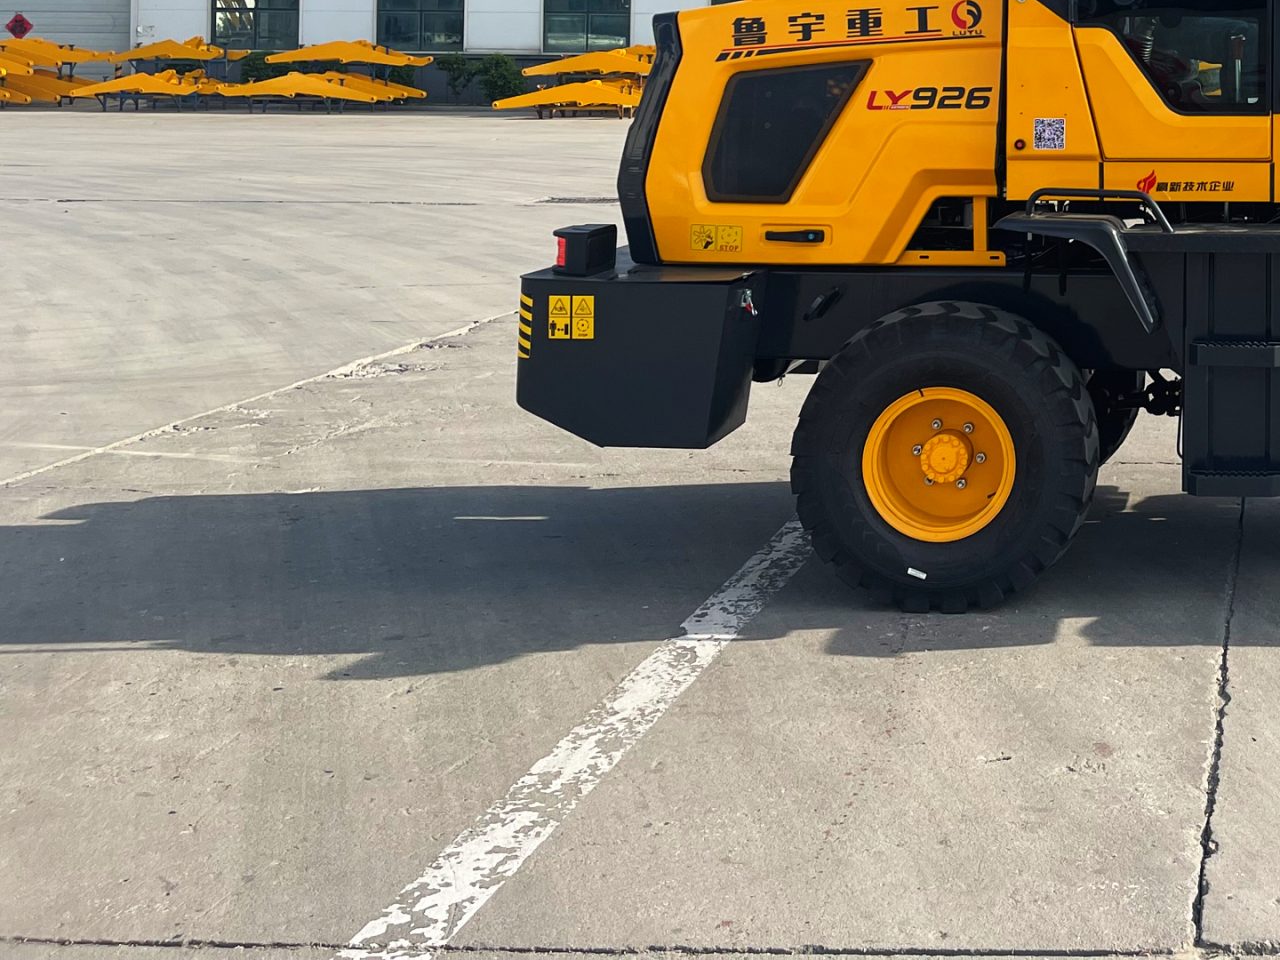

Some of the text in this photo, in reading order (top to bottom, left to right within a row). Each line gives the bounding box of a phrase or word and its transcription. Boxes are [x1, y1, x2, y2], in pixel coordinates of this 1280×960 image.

[732, 6, 942, 46] 鲁宇重工
[866, 86, 993, 111] LY926
[1156, 181, 1235, 193] 高新技术企业
[719, 244, 740, 252] STOP
